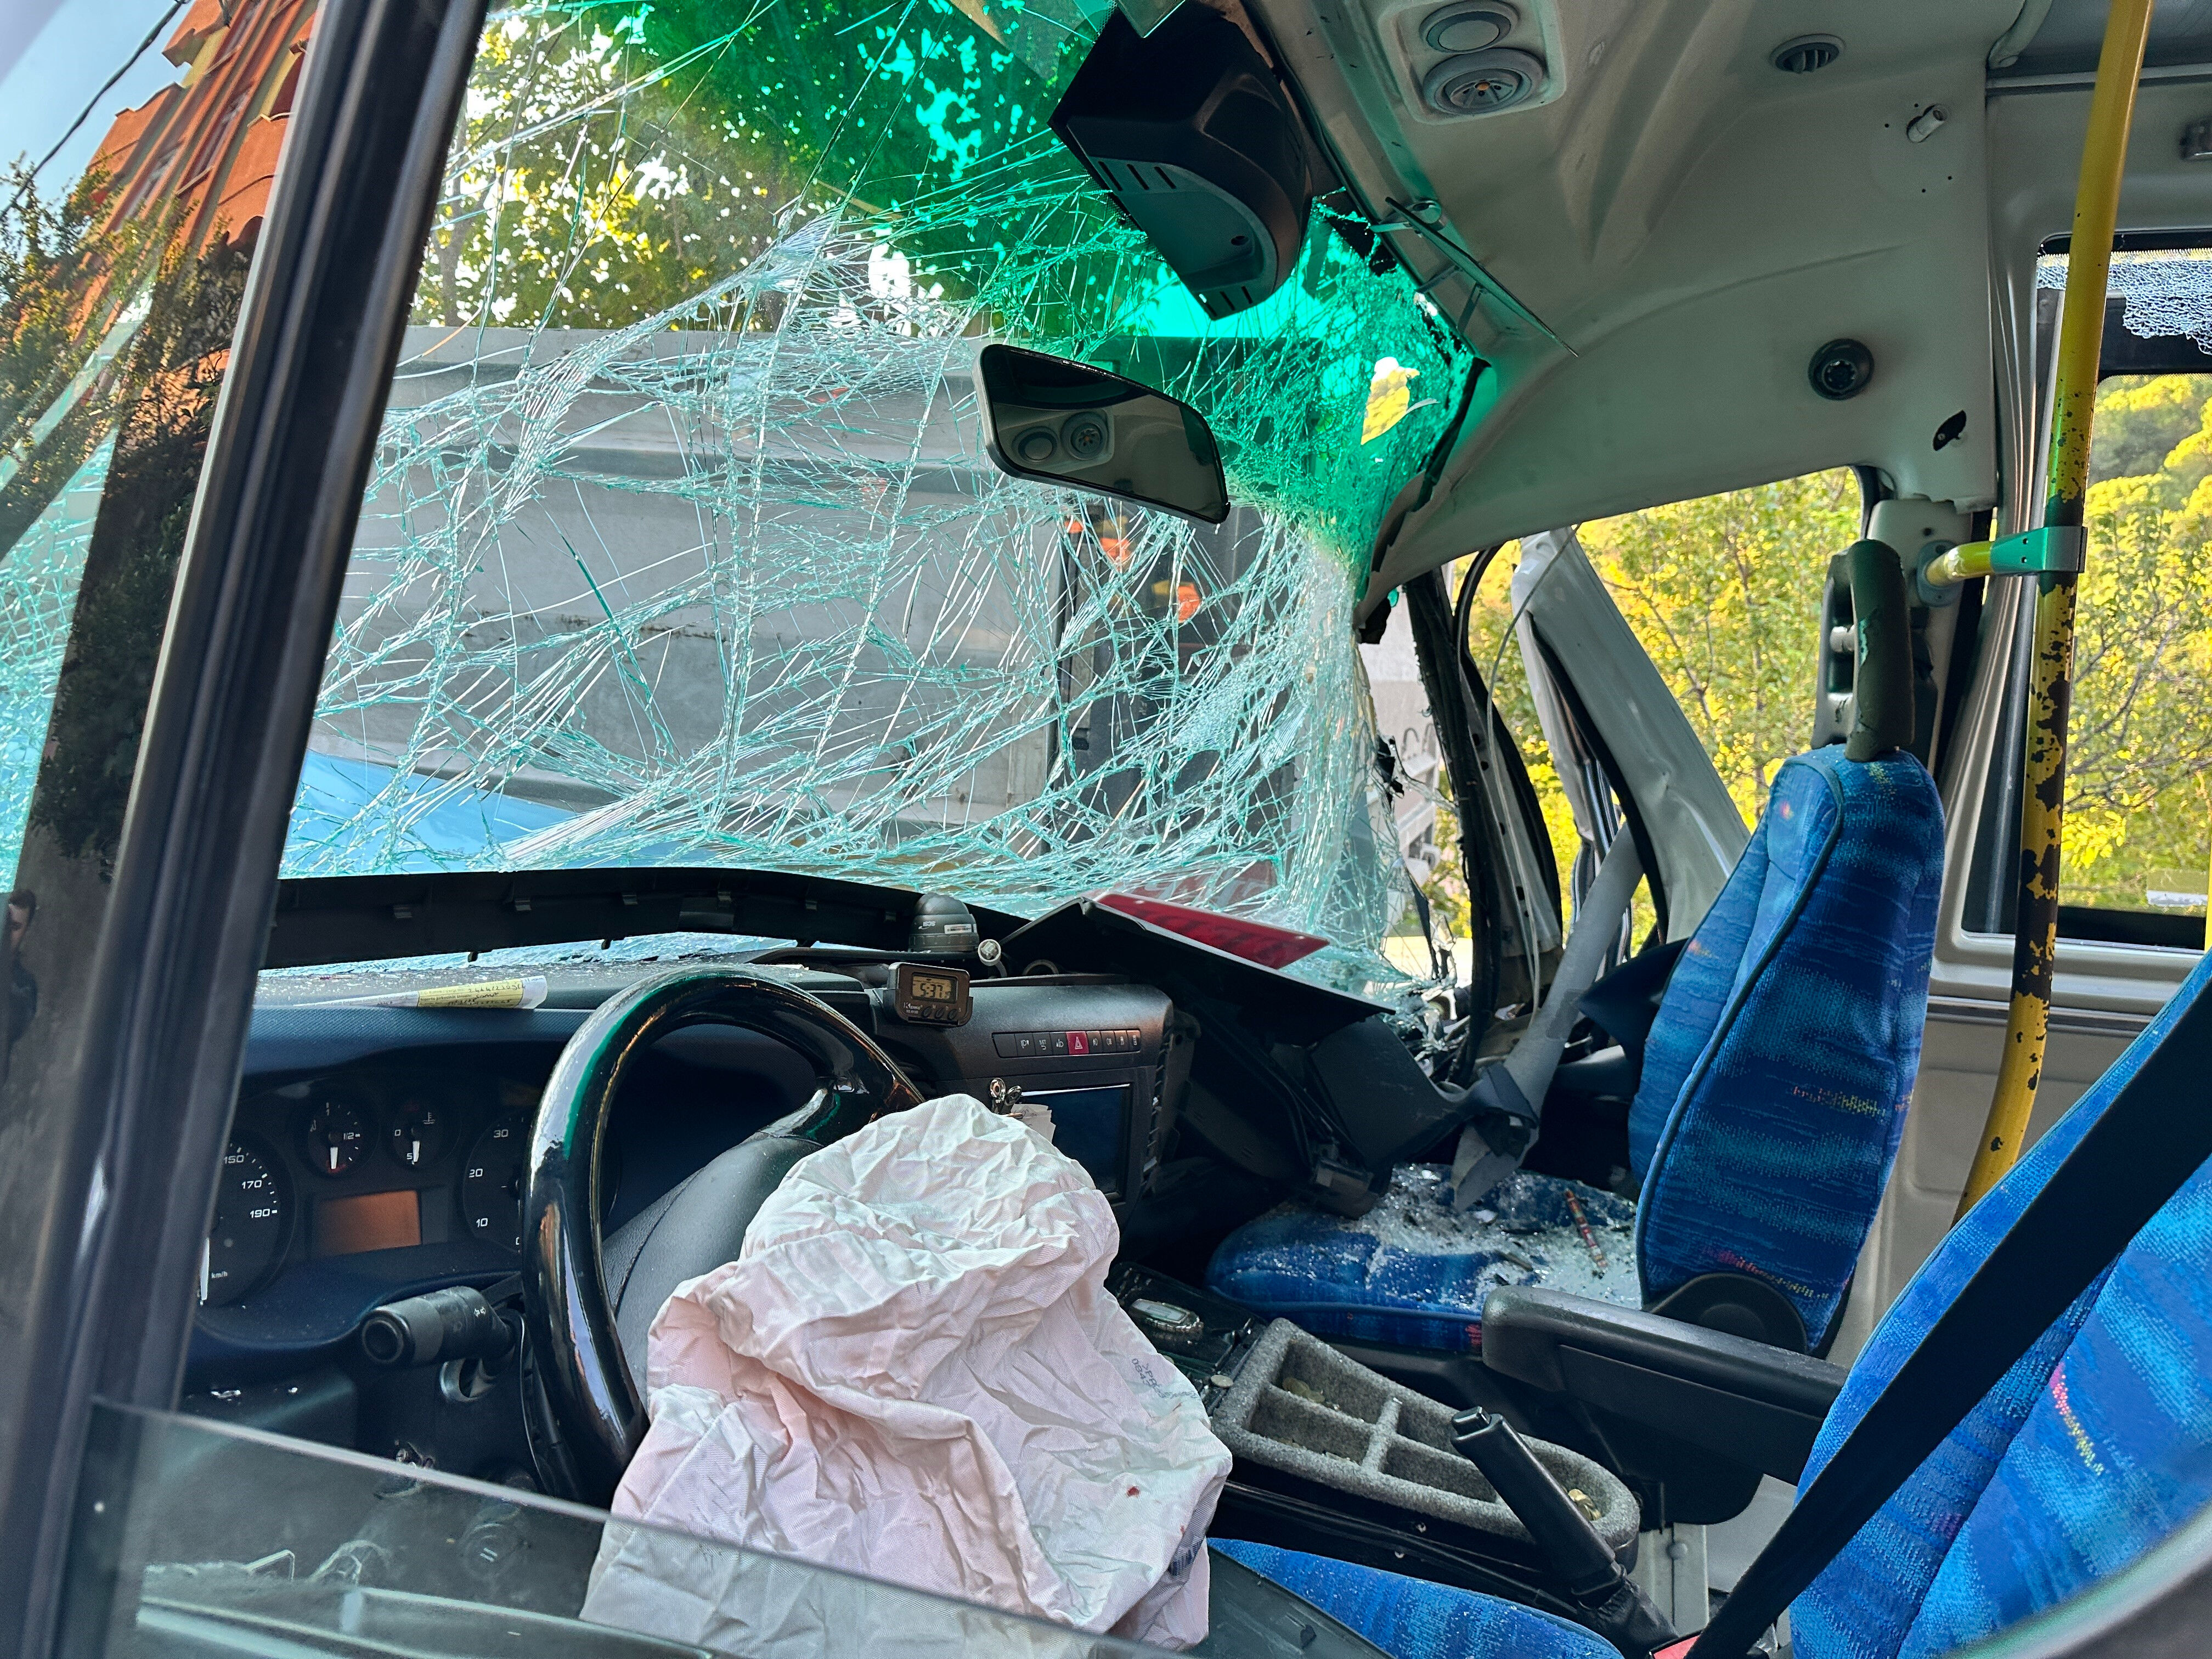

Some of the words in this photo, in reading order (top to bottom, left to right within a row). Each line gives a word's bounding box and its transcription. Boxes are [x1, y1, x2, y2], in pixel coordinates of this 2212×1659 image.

[494, 1129, 509, 1138] 30
[223, 1155, 244, 1164] 150
[469, 1168, 483, 1178] 20
[241, 1180, 262, 1189] 170
[250, 1208, 270, 1218] 190
[476, 1217, 488, 1227] 10
[211, 1271, 228, 1279] km/h
